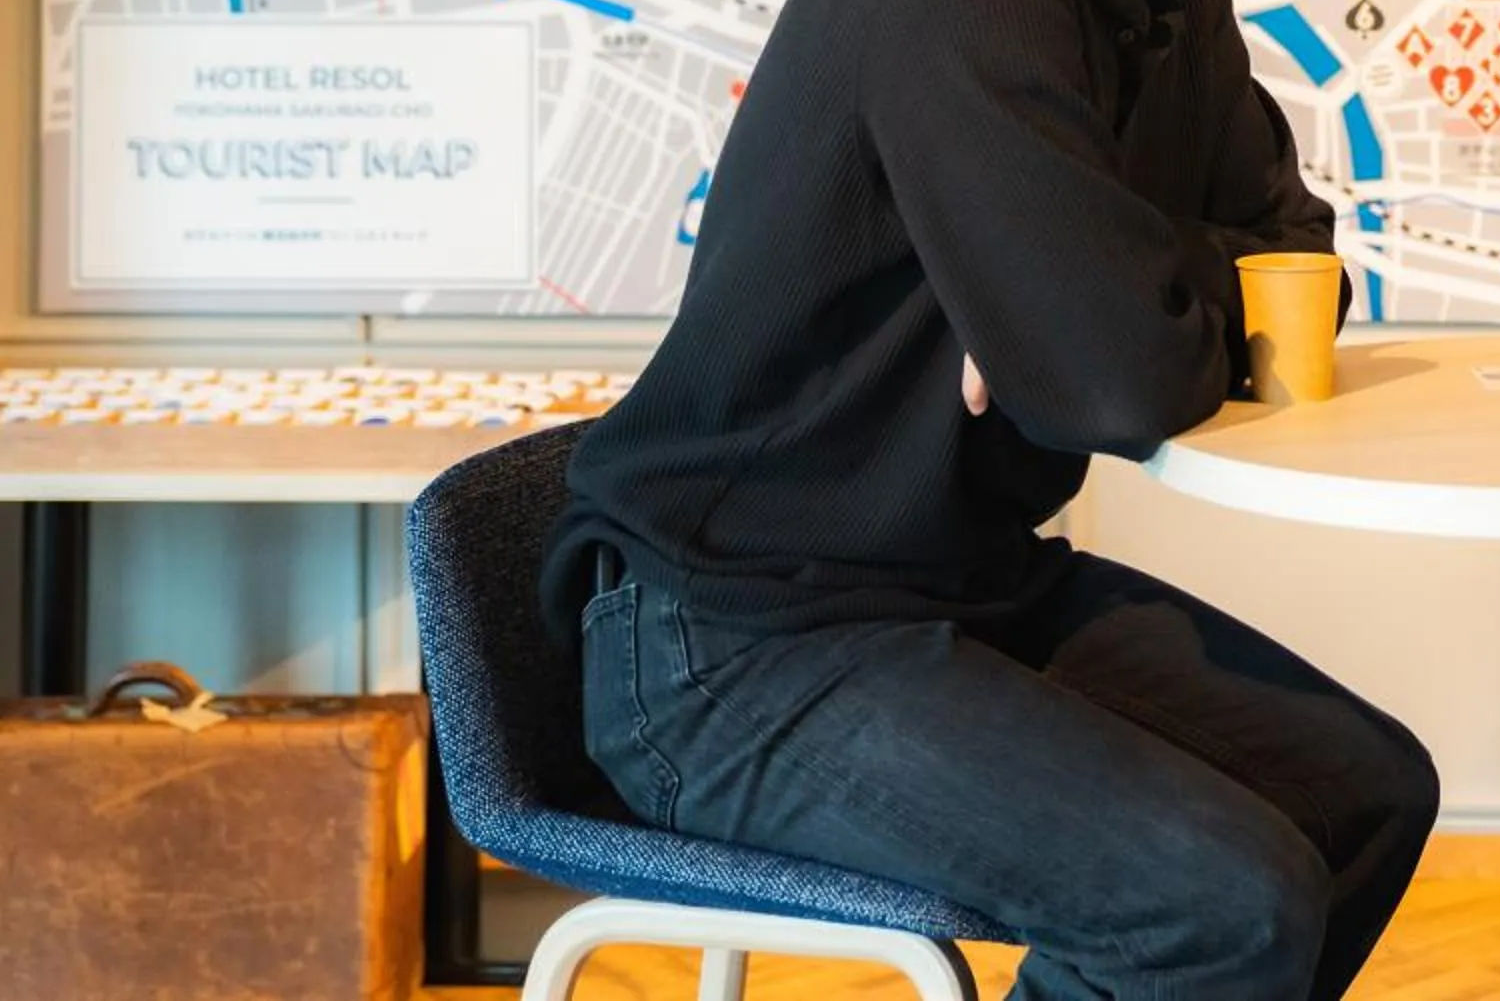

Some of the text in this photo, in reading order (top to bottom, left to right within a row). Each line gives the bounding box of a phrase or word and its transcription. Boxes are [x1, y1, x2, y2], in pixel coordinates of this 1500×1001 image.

[1457, 17, 1477, 44] 7
[195, 66, 412, 91] HOTEL RESOL
[1443, 74, 1460, 102] 8
[1477, 99, 1494, 125] 3
[126, 137, 479, 180] TOURIST MAP
